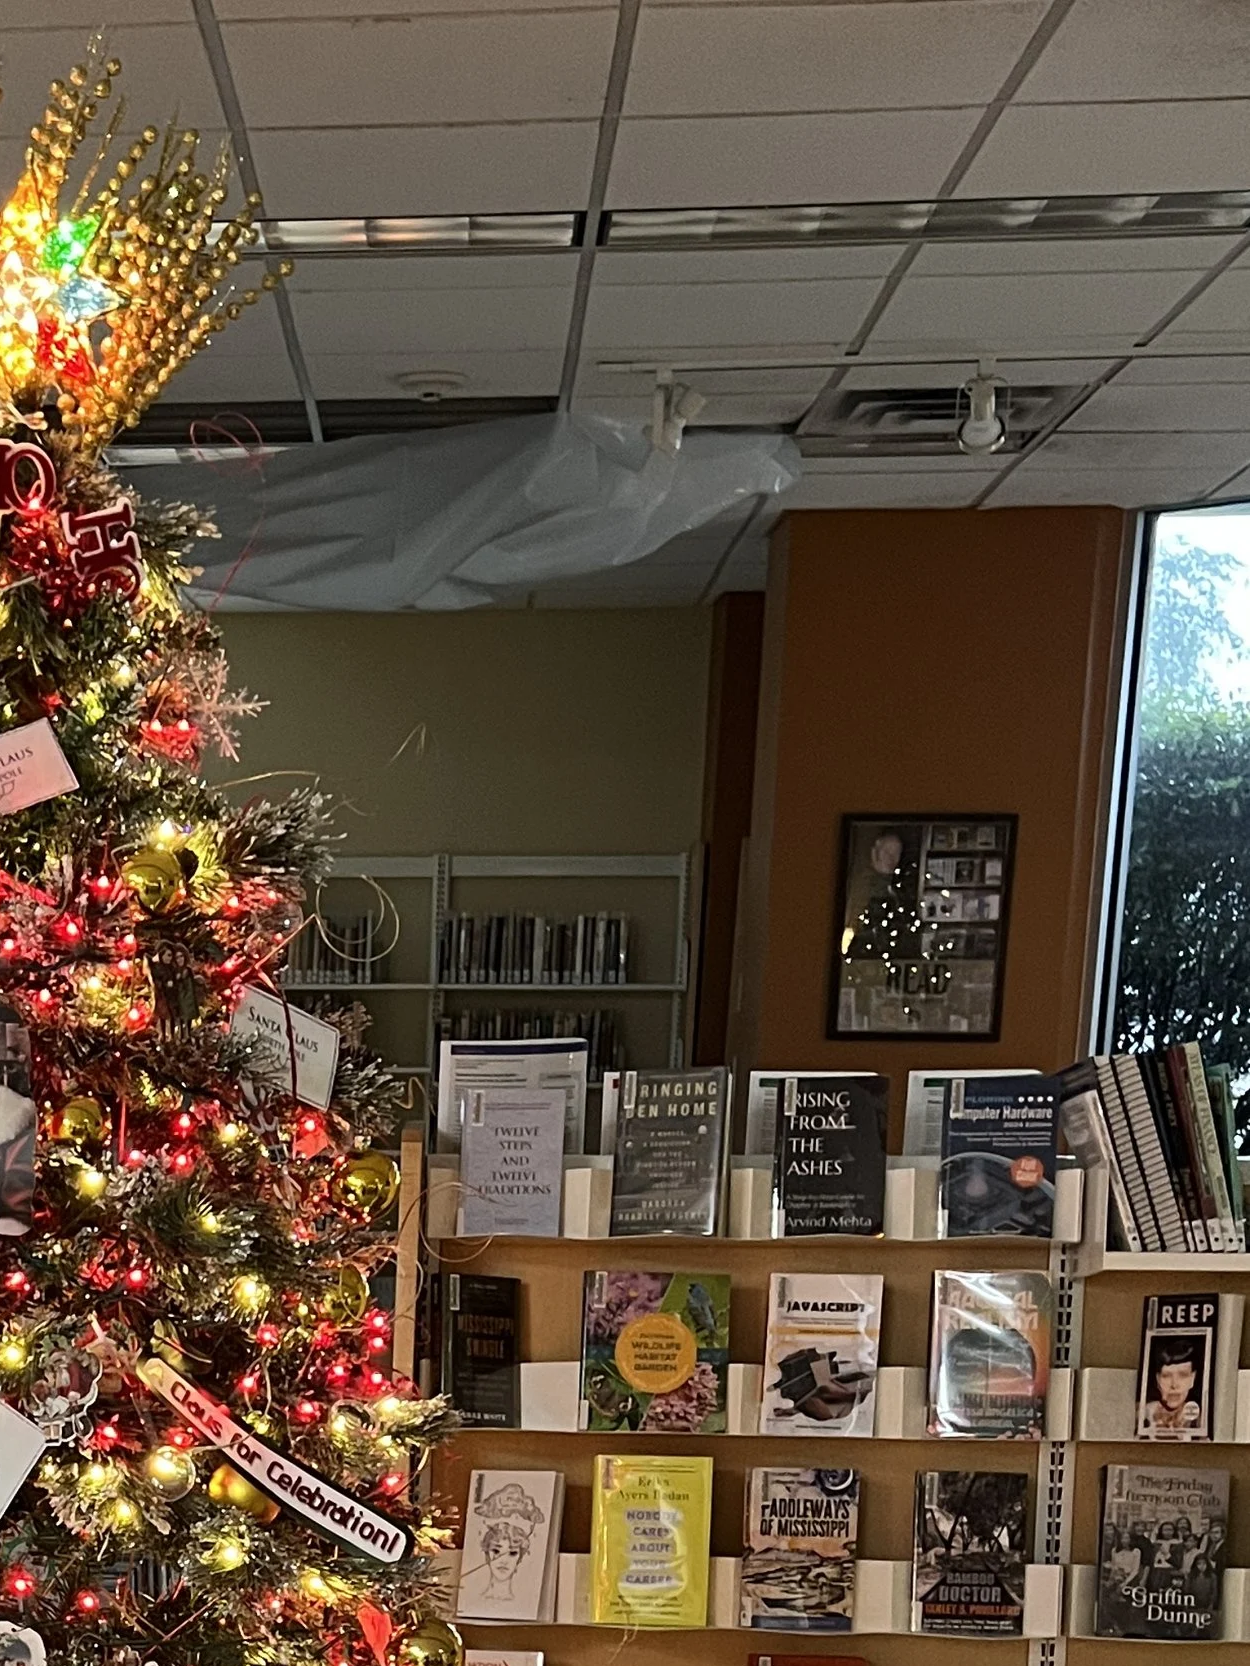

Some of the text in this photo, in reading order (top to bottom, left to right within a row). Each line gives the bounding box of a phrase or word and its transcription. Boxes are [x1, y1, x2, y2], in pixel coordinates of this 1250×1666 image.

[248, 1006, 282, 1035] SANTA
[292, 1026, 319, 1053] LAUS
[640, 1081, 718, 1097] RINGING
[795, 1091, 850, 1109] RISING
[667, 1102, 717, 1116] HOME
[789, 1114, 848, 1130] FROM
[495, 1126, 540, 1137] TWELVE
[500, 1140, 532, 1151] STEPS
[789, 1137, 824, 1153] THE
[500, 1156, 530, 1166] AND
[787, 1160, 843, 1176] ASHES
[492, 1171, 537, 1182] TWELVE
[786, 1216, 872, 1227] Arvind Mehta
[786, 1301, 865, 1313] JAVASCRIPT
[1161, 1304, 1215, 1324] REEP
[171, 1381, 223, 1439] Claus
[230, 1433, 262, 1466] for
[266, 1461, 400, 1553] Celebration!
[760, 1519, 849, 1537] OF MISSISSIPPI
[631, 1543, 670, 1552] ABOUT
[939, 1586, 1001, 1602] DOCTOR
[1121, 1586, 1195, 1608] Griffin
[1147, 1605, 1212, 1629] Dunne
